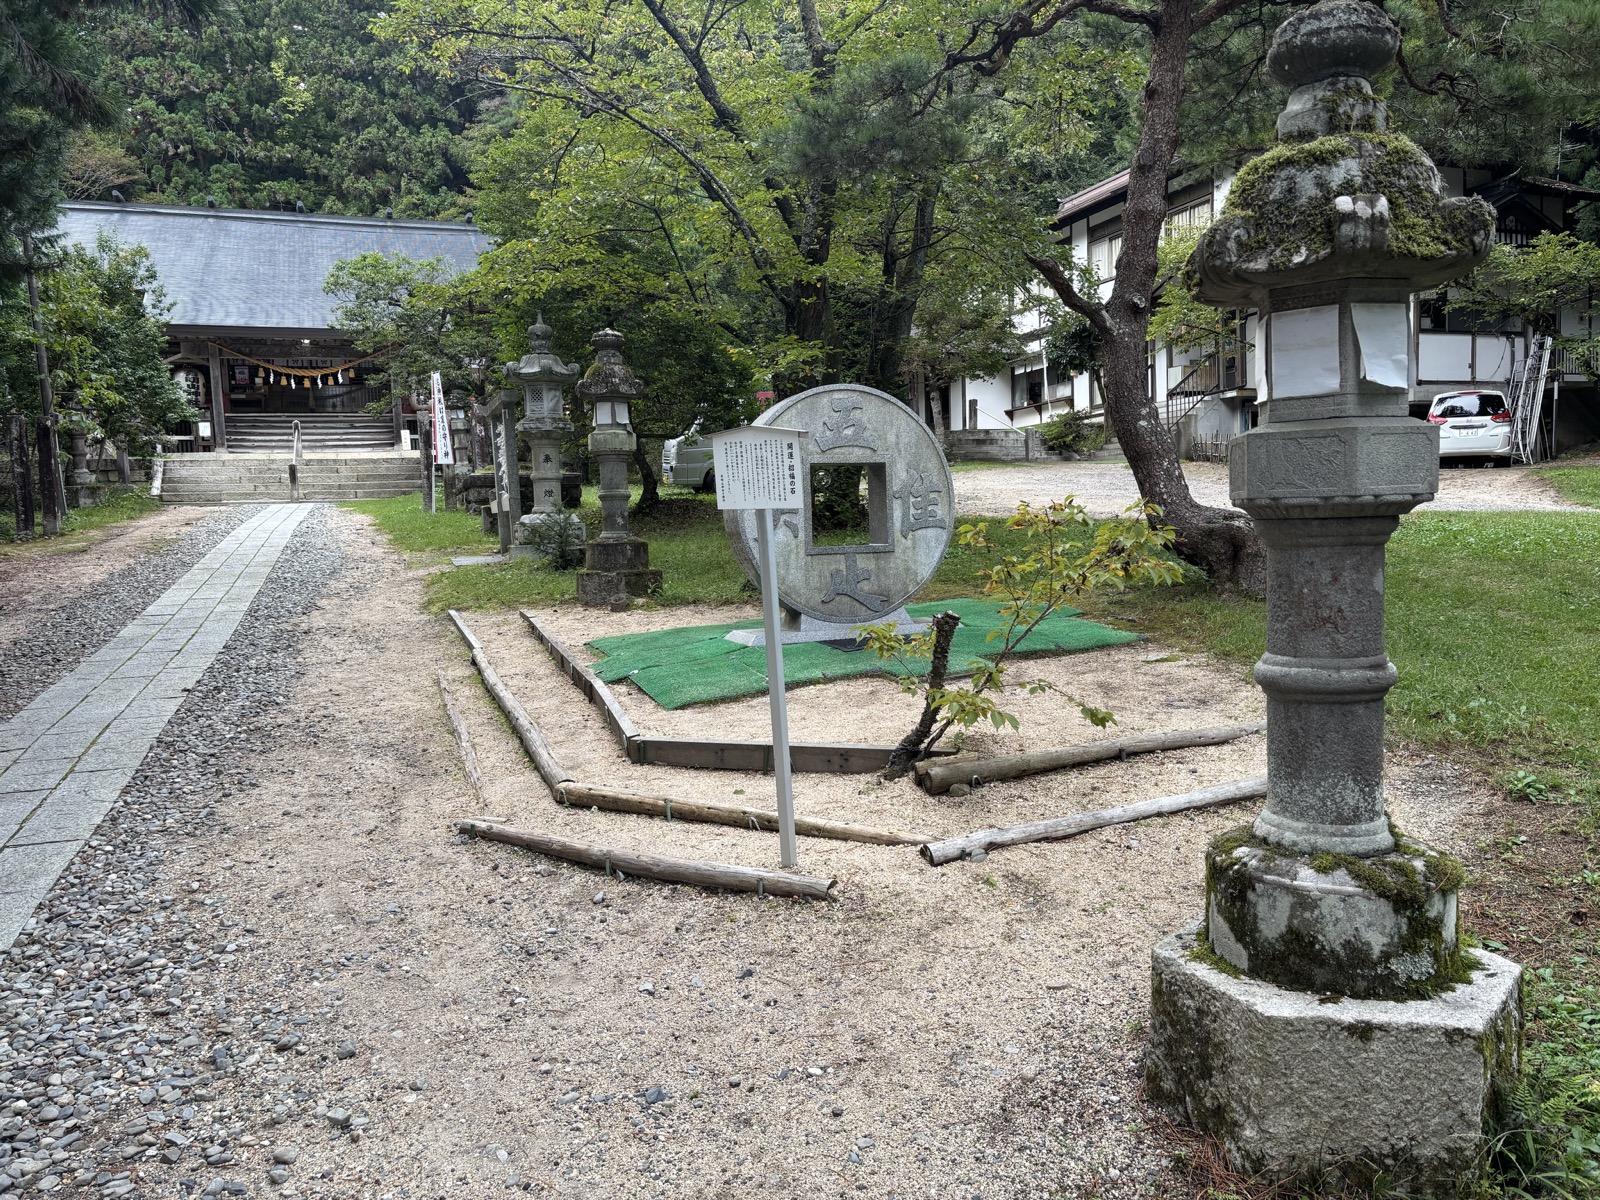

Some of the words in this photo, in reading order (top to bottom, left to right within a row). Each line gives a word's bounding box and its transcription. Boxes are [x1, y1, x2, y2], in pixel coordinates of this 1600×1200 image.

[786, 442, 796, 495] 開運・招福の石
